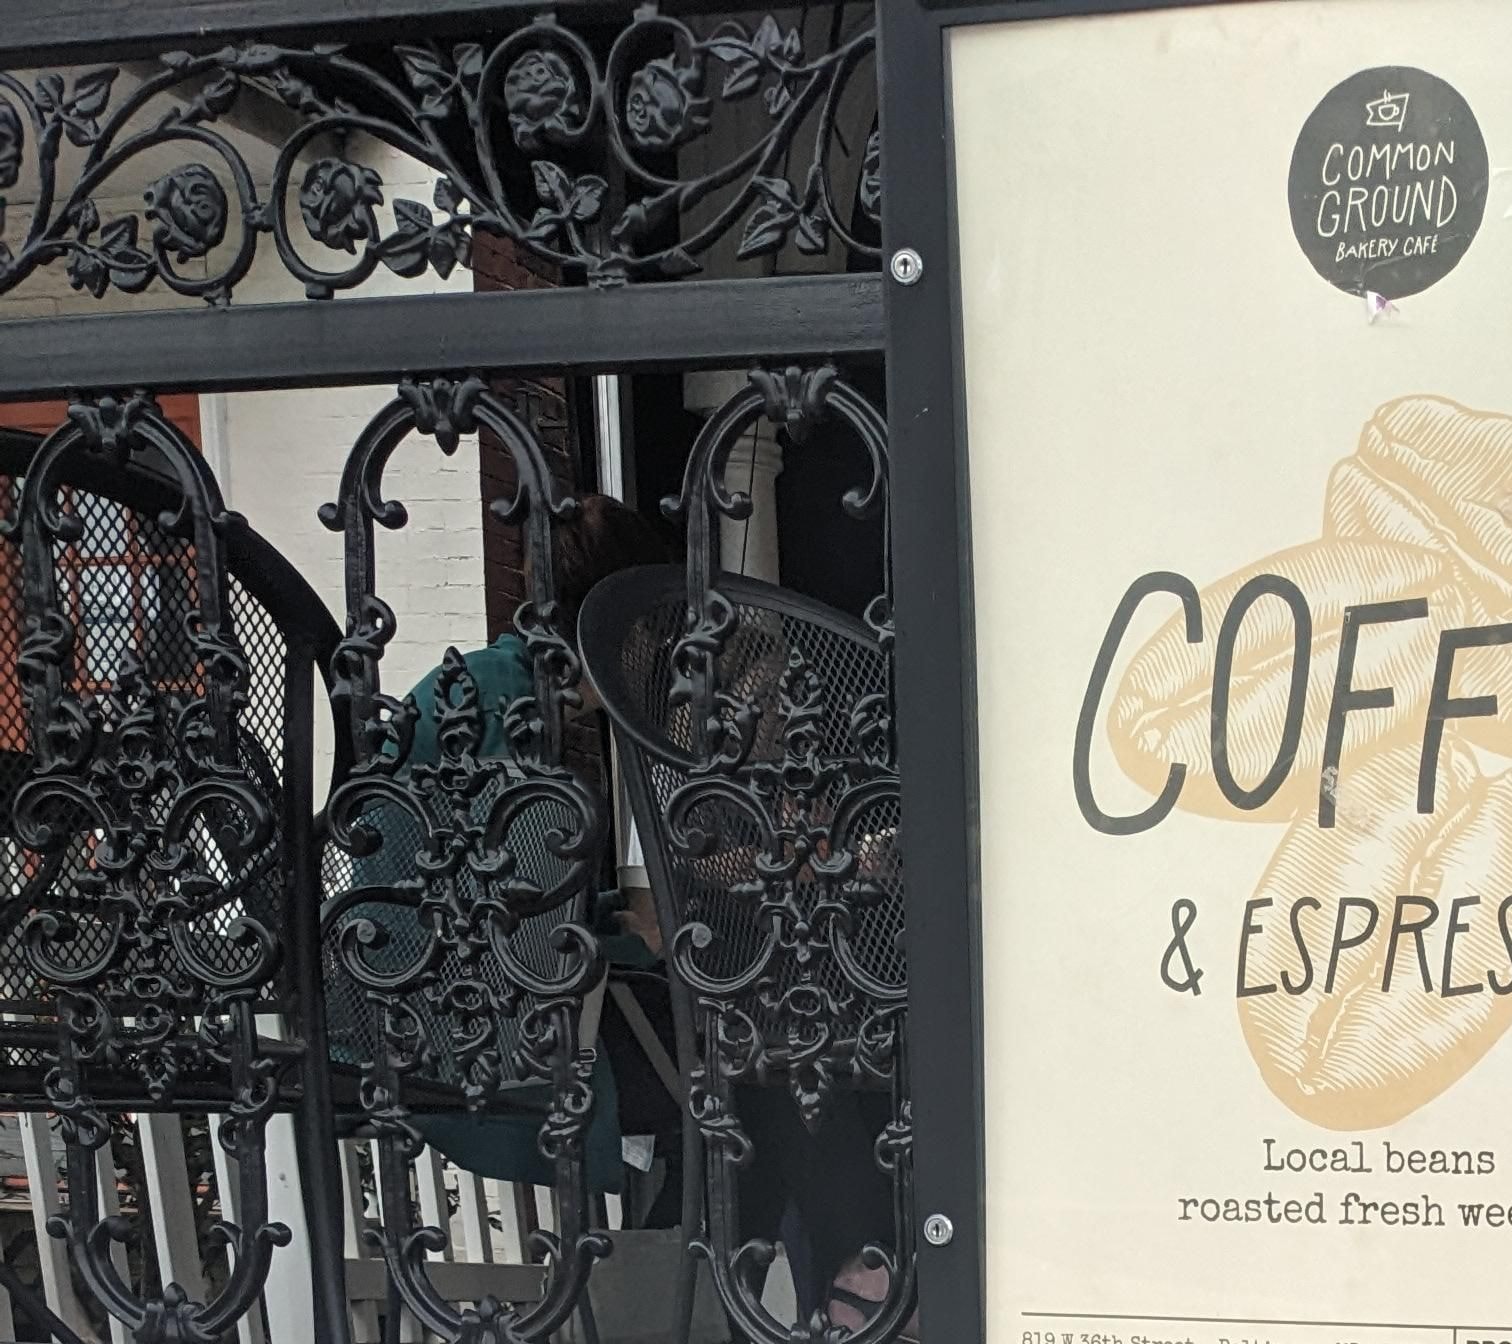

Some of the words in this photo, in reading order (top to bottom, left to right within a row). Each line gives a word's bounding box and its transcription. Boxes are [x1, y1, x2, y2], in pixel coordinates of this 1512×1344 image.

[1322, 140, 1454, 186] COMMON
[1317, 174, 1457, 237] GROUND
[1335, 238, 1399, 263] BAKERY
[1160, 898, 1203, 996] &
[1263, 1139, 1373, 1173] Local
[1383, 1142, 1496, 1175] beans
[1178, 1191, 1327, 1225] roasted
[1338, 1192, 1446, 1227] fresh
